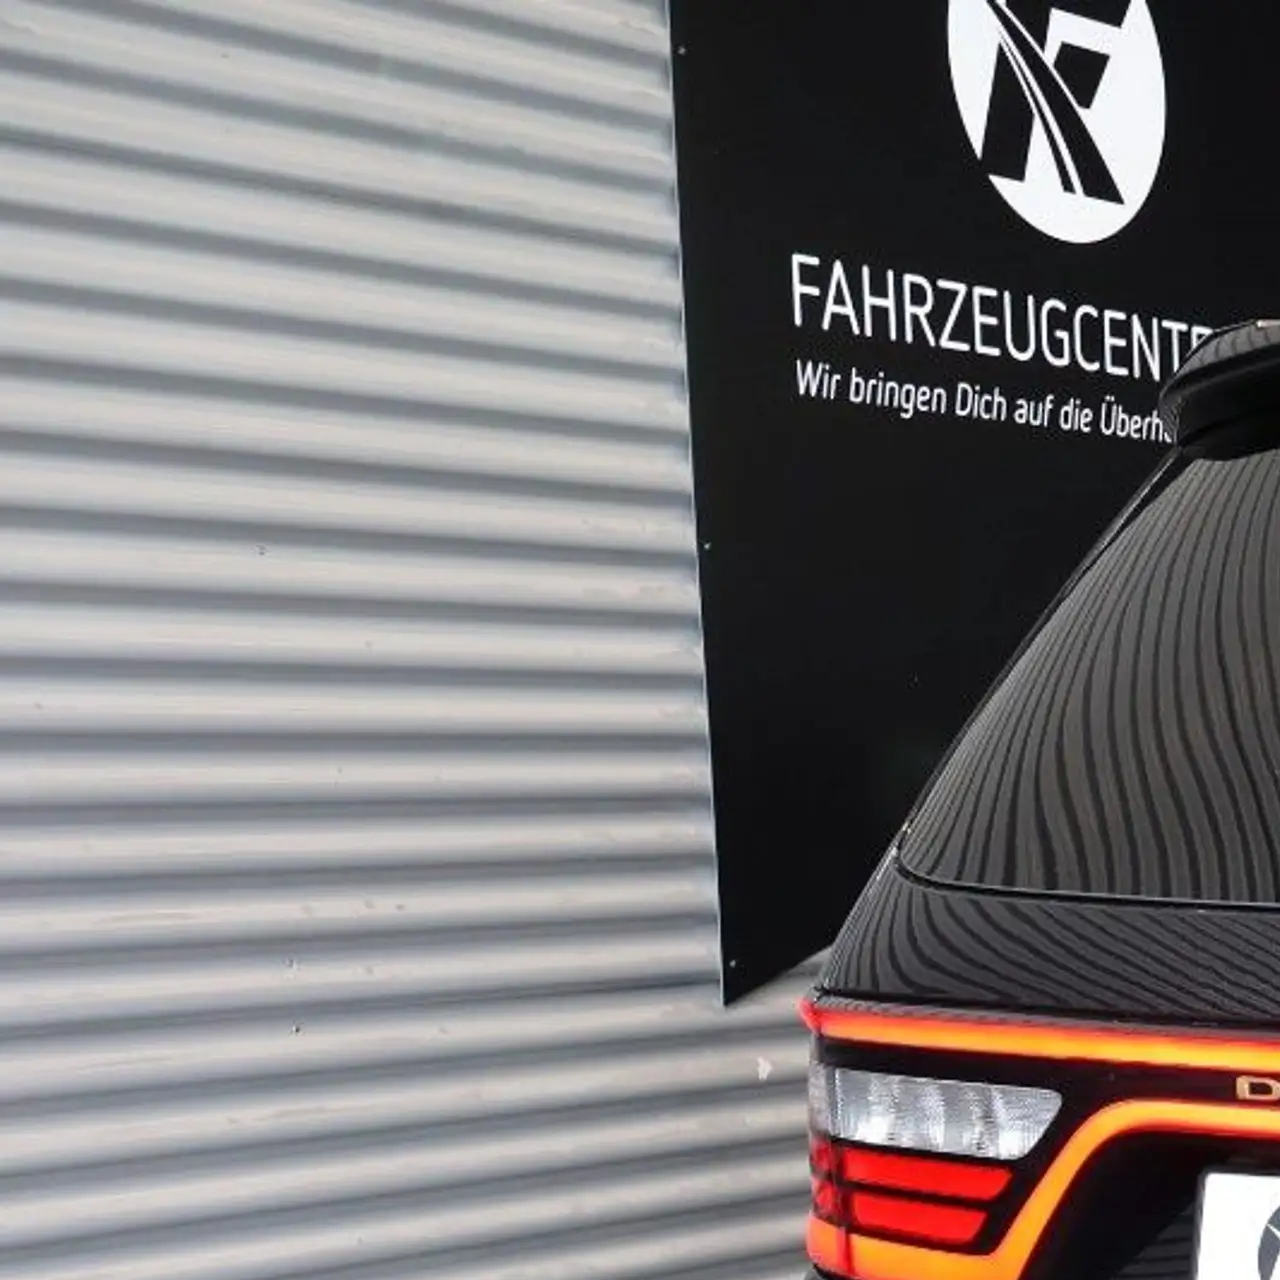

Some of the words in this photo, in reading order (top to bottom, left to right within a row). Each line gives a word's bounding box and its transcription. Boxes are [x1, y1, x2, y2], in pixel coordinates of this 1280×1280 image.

[796, 359, 841, 400] Wir
[849, 366, 948, 420] bringen
[954, 381, 1008, 422] Dich
[1013, 393, 1055, 428] auf
[1059, 397, 1094, 434] die
[1100, 394, 1173, 444] Überh
